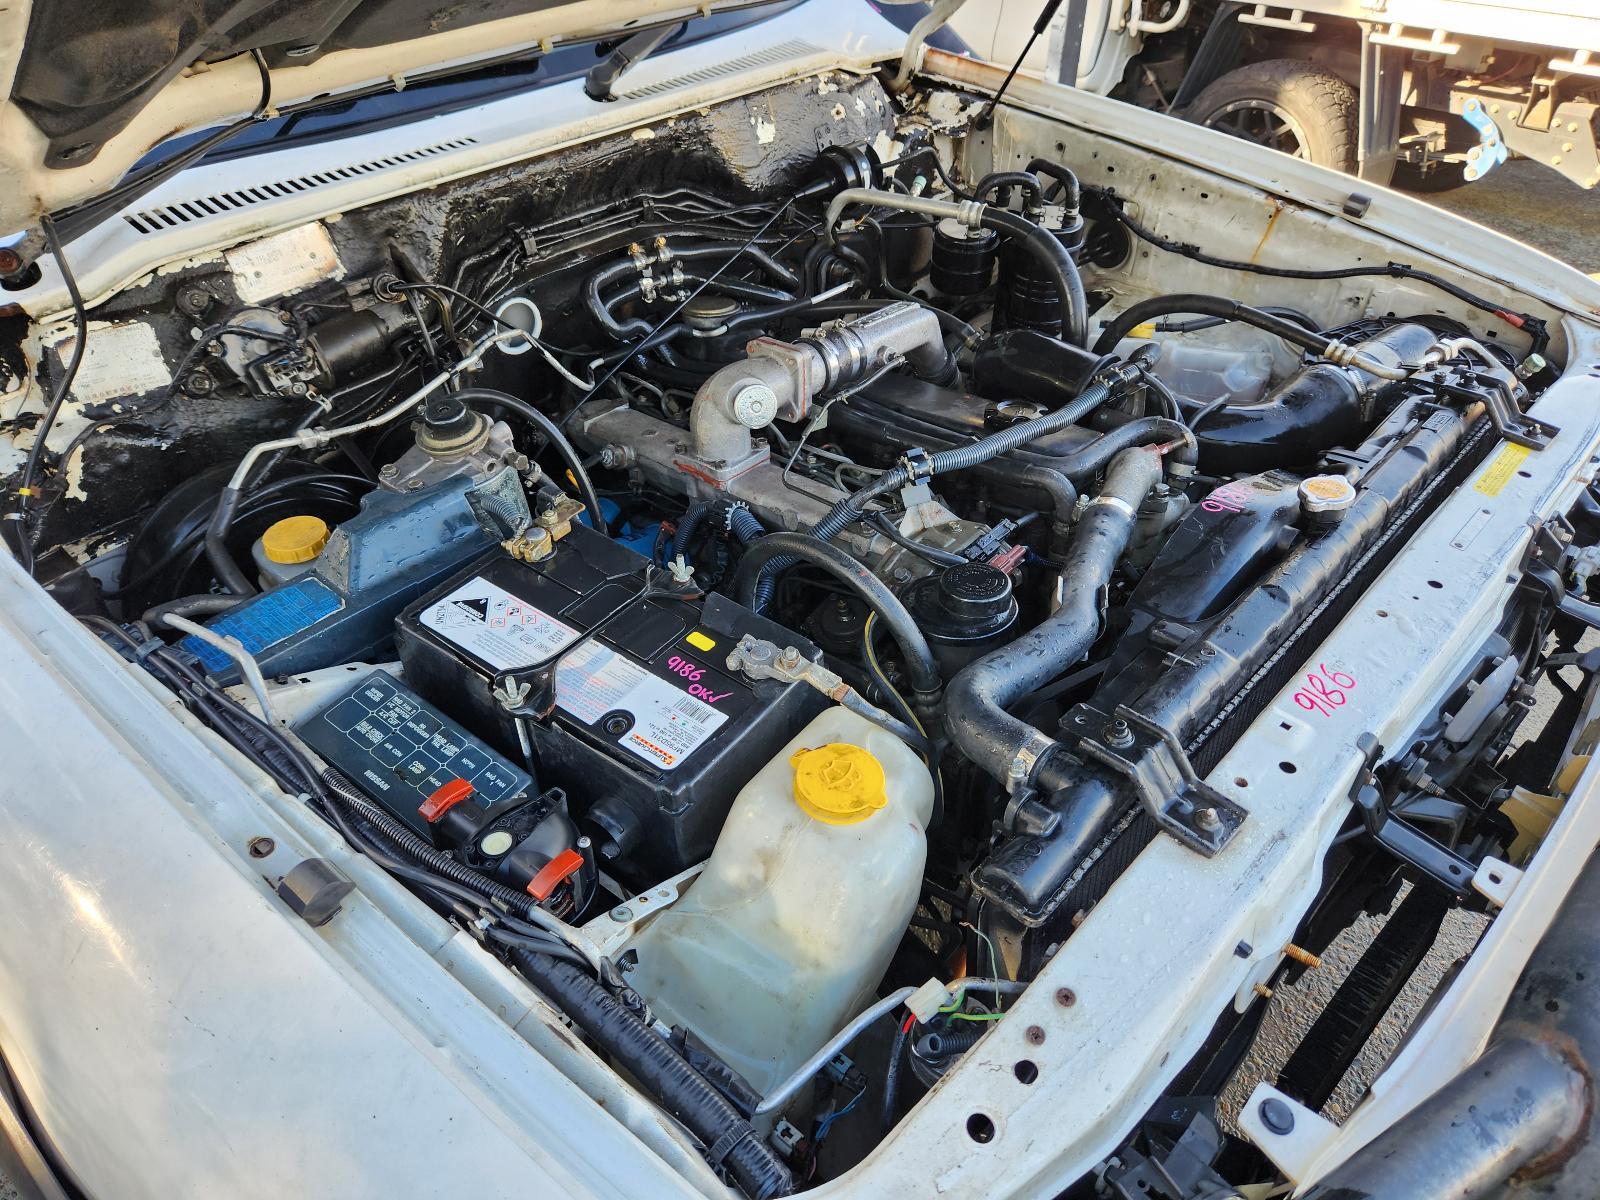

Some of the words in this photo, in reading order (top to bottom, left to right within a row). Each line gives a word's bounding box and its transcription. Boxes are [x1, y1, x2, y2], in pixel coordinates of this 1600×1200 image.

[667, 656, 706, 681] 9186
[688, 683, 713, 700] OK
[1294, 663, 1357, 718] 9186
[363, 769, 391, 791] NISSAN
